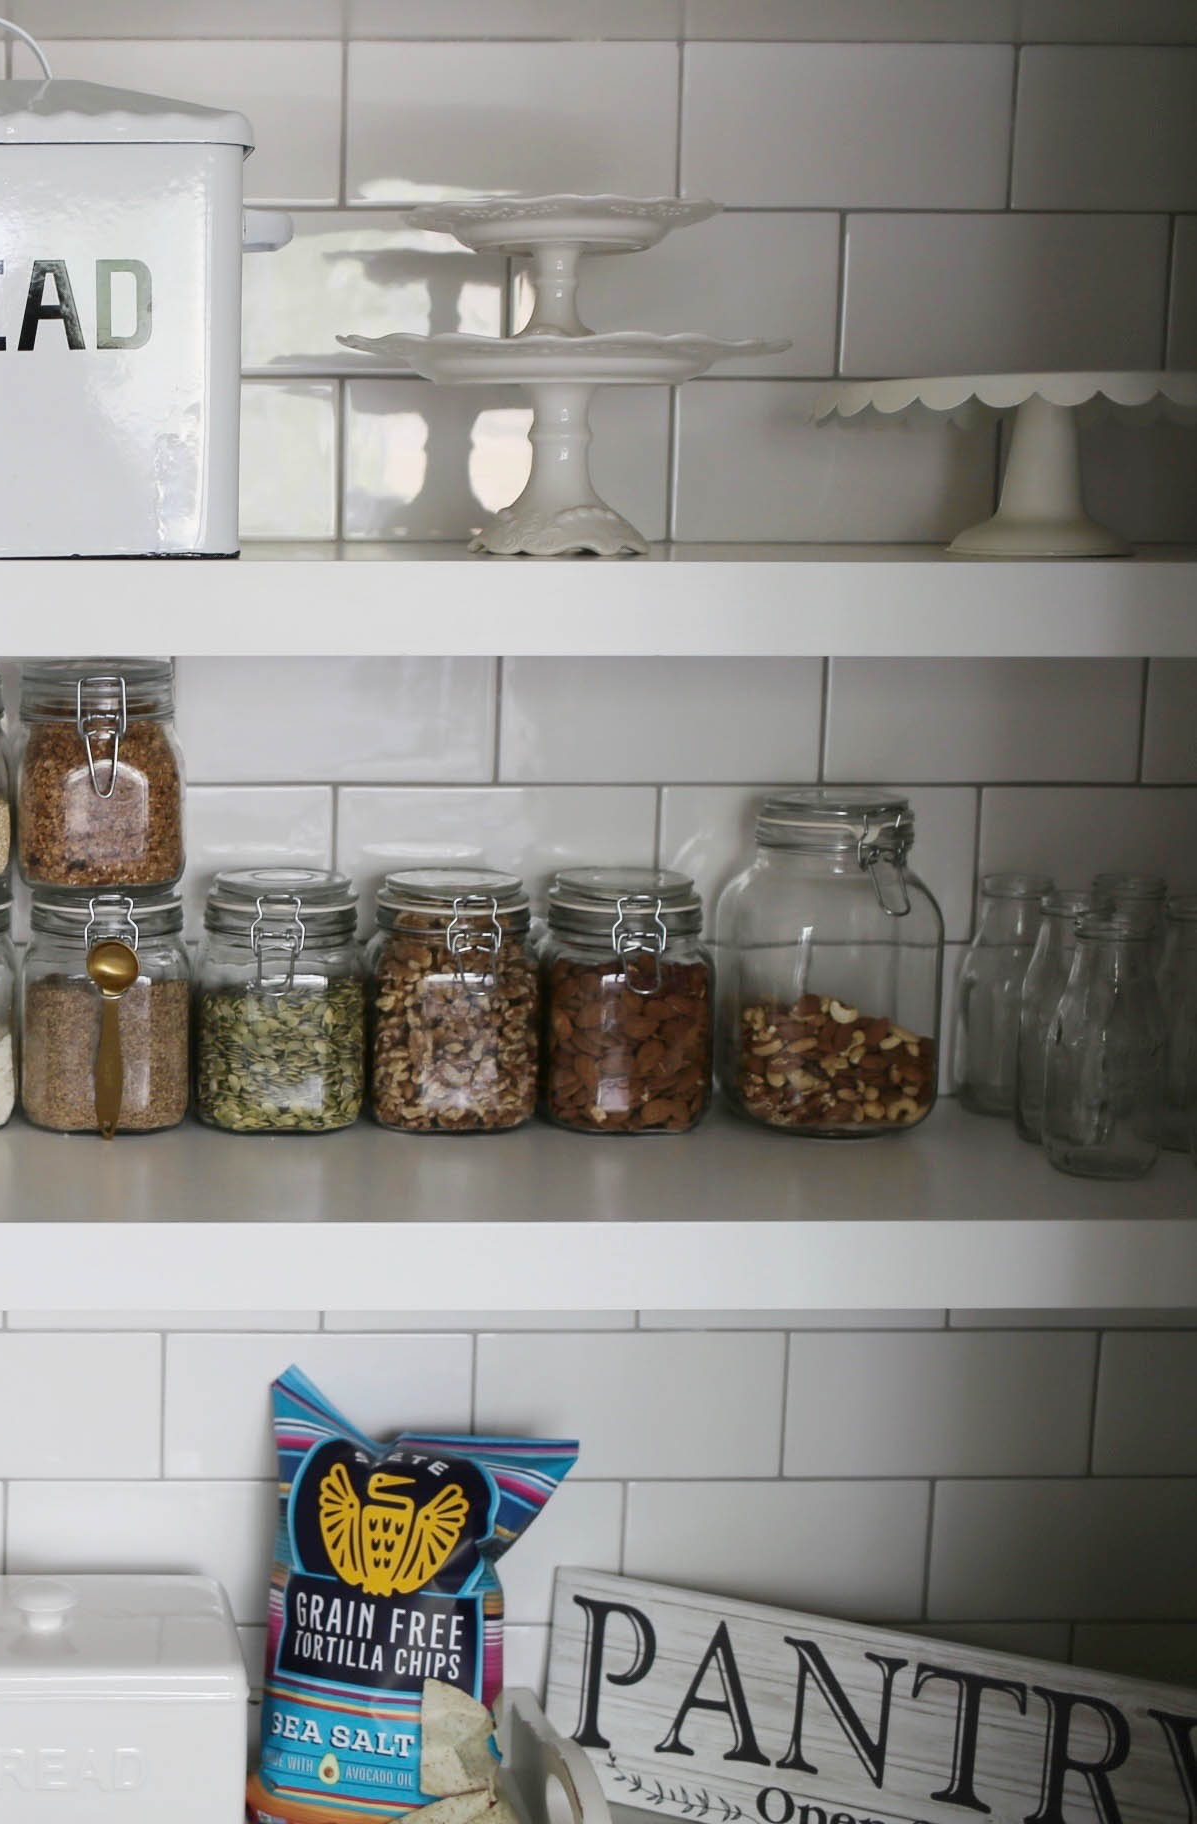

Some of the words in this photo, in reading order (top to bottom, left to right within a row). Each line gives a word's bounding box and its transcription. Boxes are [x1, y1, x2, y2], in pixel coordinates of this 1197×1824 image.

[296, 1592, 376, 1640] GRAIN
[389, 1608, 465, 1651] FREE
[294, 1630, 383, 1672] TORTILLA
[394, 1648, 461, 1680] CHIPS
[271, 1711, 324, 1745] SEA
[331, 1725, 416, 1758] SALT
[287, 1755, 314, 1773] WITH
[345, 1765, 394, 1785] AVOCADO
[397, 1773, 413, 1787] OIL
